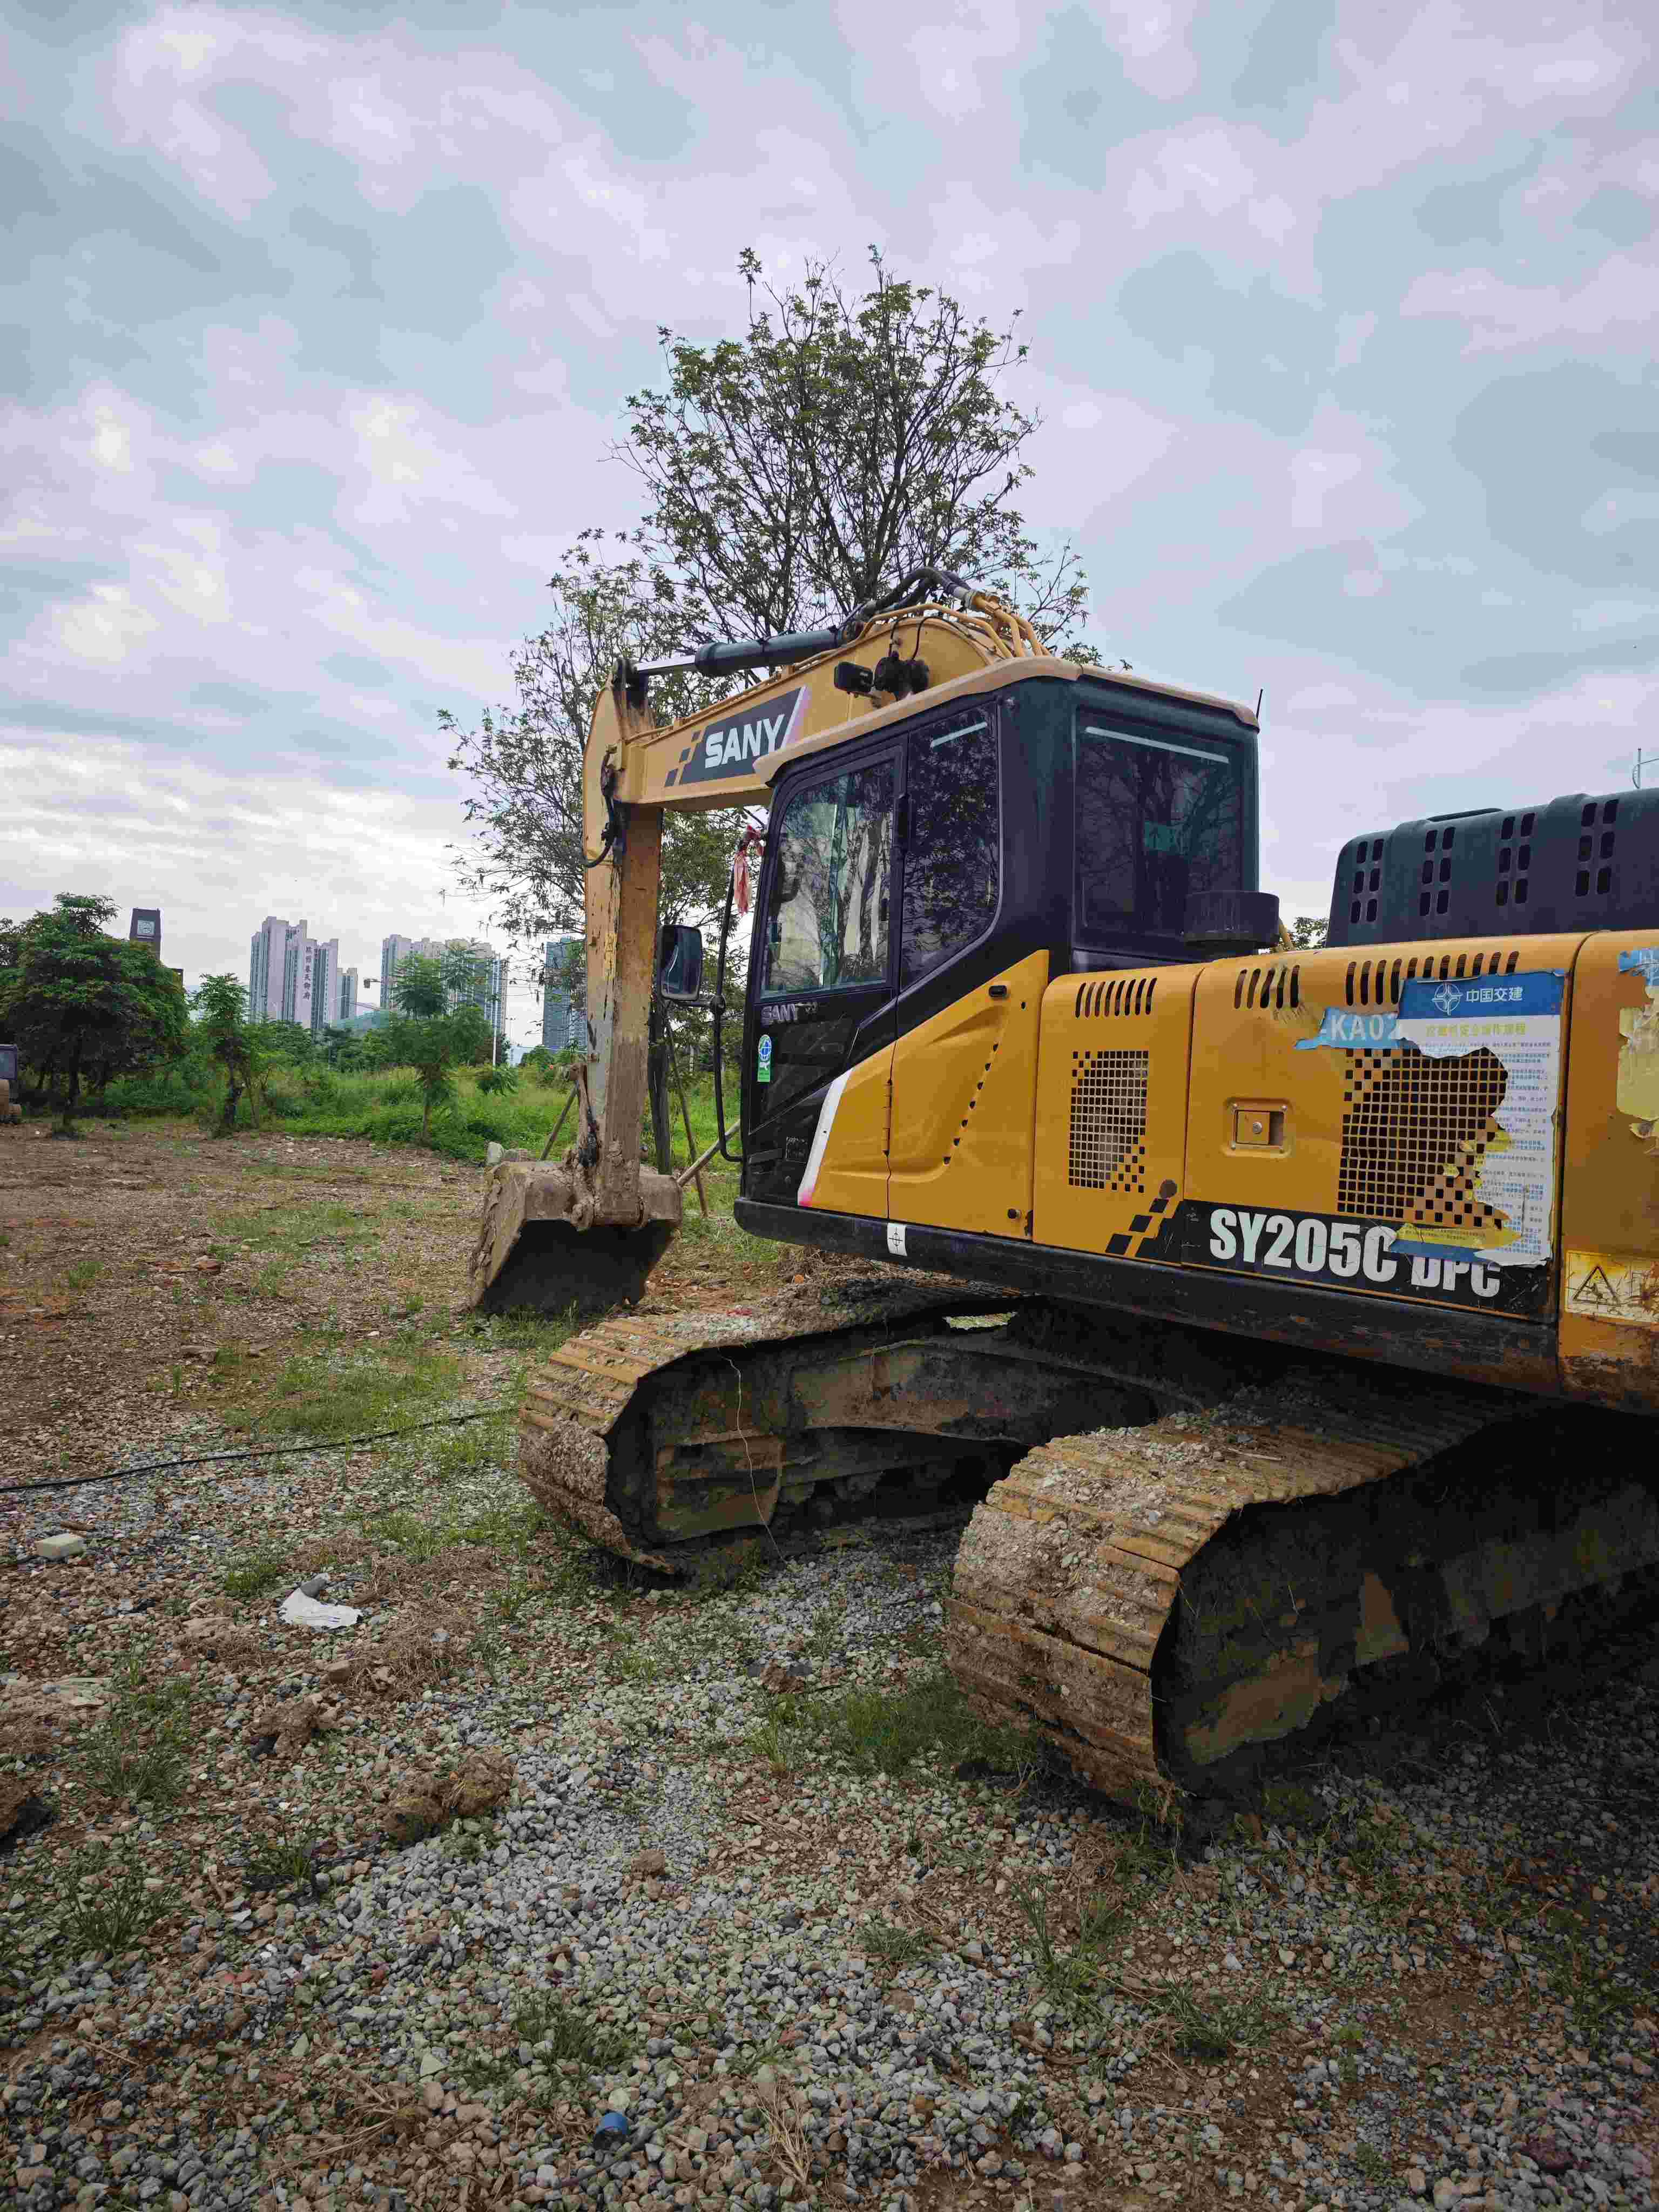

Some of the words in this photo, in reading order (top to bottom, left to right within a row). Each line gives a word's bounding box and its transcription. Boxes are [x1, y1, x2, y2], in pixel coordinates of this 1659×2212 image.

[705, 714, 785, 769] SANY
[1466, 986, 1523, 1003] 中国交建
[761, 1003, 799, 1025] SANY
[1209, 1208, 1398, 1283] SY205C
